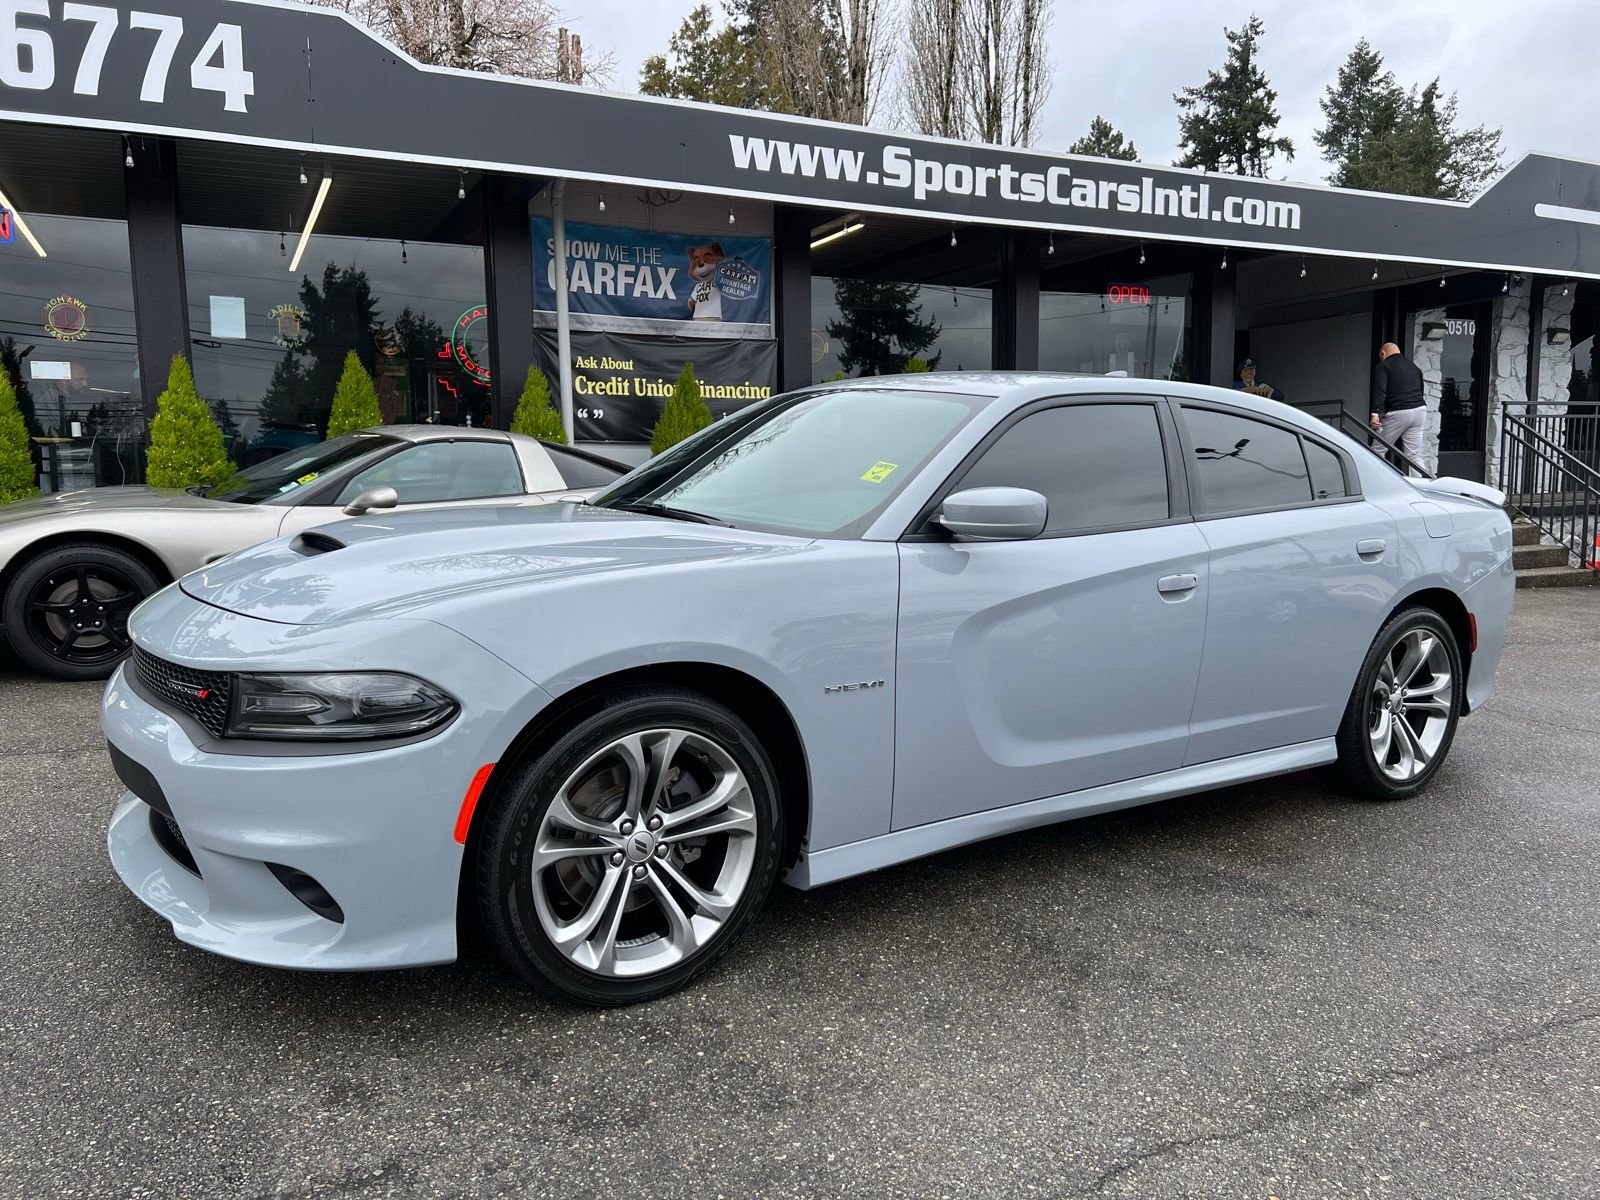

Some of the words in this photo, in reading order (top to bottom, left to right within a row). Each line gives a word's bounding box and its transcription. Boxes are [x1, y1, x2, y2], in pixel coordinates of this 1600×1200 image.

[0, 0, 254, 113] 6774
[728, 134, 1301, 229] www.SportsCarsIntl.com
[605, 244, 629, 263] ME
[633, 246, 662, 265] THE
[720, 267, 757, 284] CARFAX
[720, 277, 752, 292] ADVANTAGE
[722, 286, 745, 297] DEALER
[1109, 285, 1149, 305] OPEN
[267, 304, 306, 320] CADILLA
[575, 356, 598, 369] Ask
[600, 357, 634, 371] About
[575, 375, 630, 396] Credit
[633, 378, 678, 398] Unio
[694, 380, 771, 400] inancing
